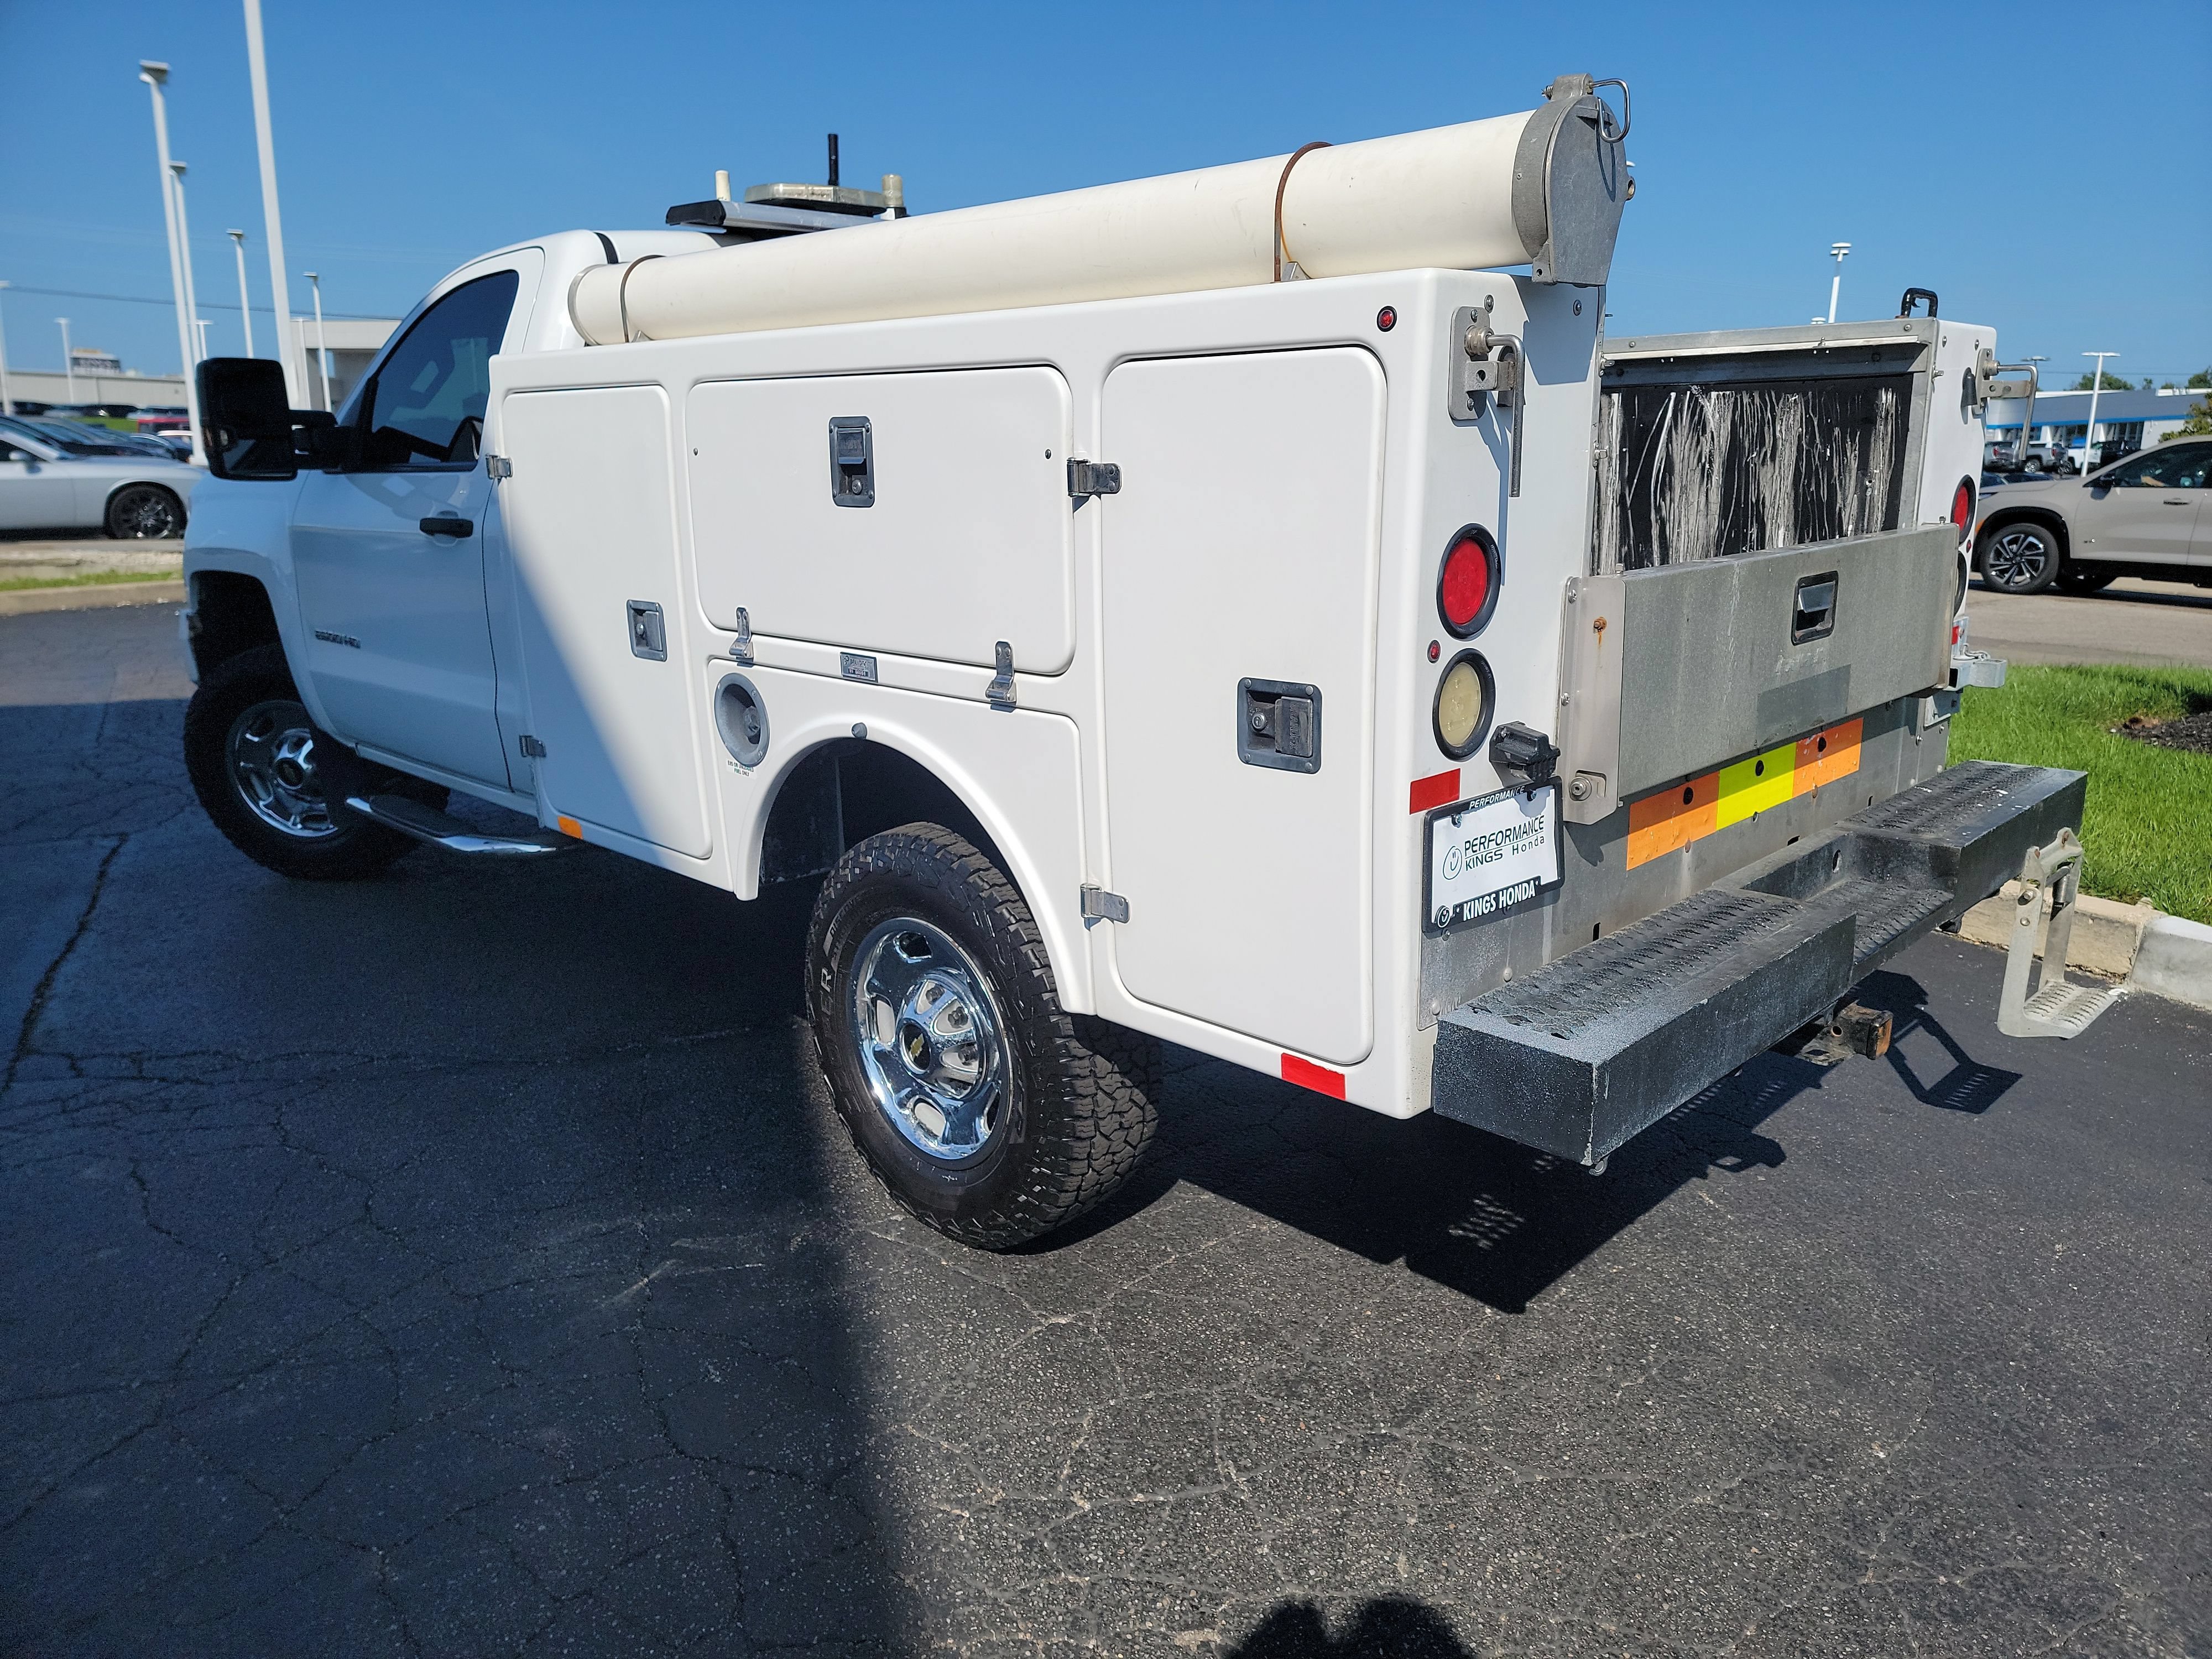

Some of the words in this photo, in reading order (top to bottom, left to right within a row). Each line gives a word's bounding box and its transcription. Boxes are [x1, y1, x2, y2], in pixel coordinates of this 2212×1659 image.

[1469, 786, 1525, 810] PERFORMANCE
[1464, 815, 1545, 857] PERFORMANCE
[1465, 849, 1503, 871] KINGS
[1512, 836, 1545, 855] Honda
[1463, 894, 1496, 921] KINGS
[1499, 880, 1536, 909] HONDA
